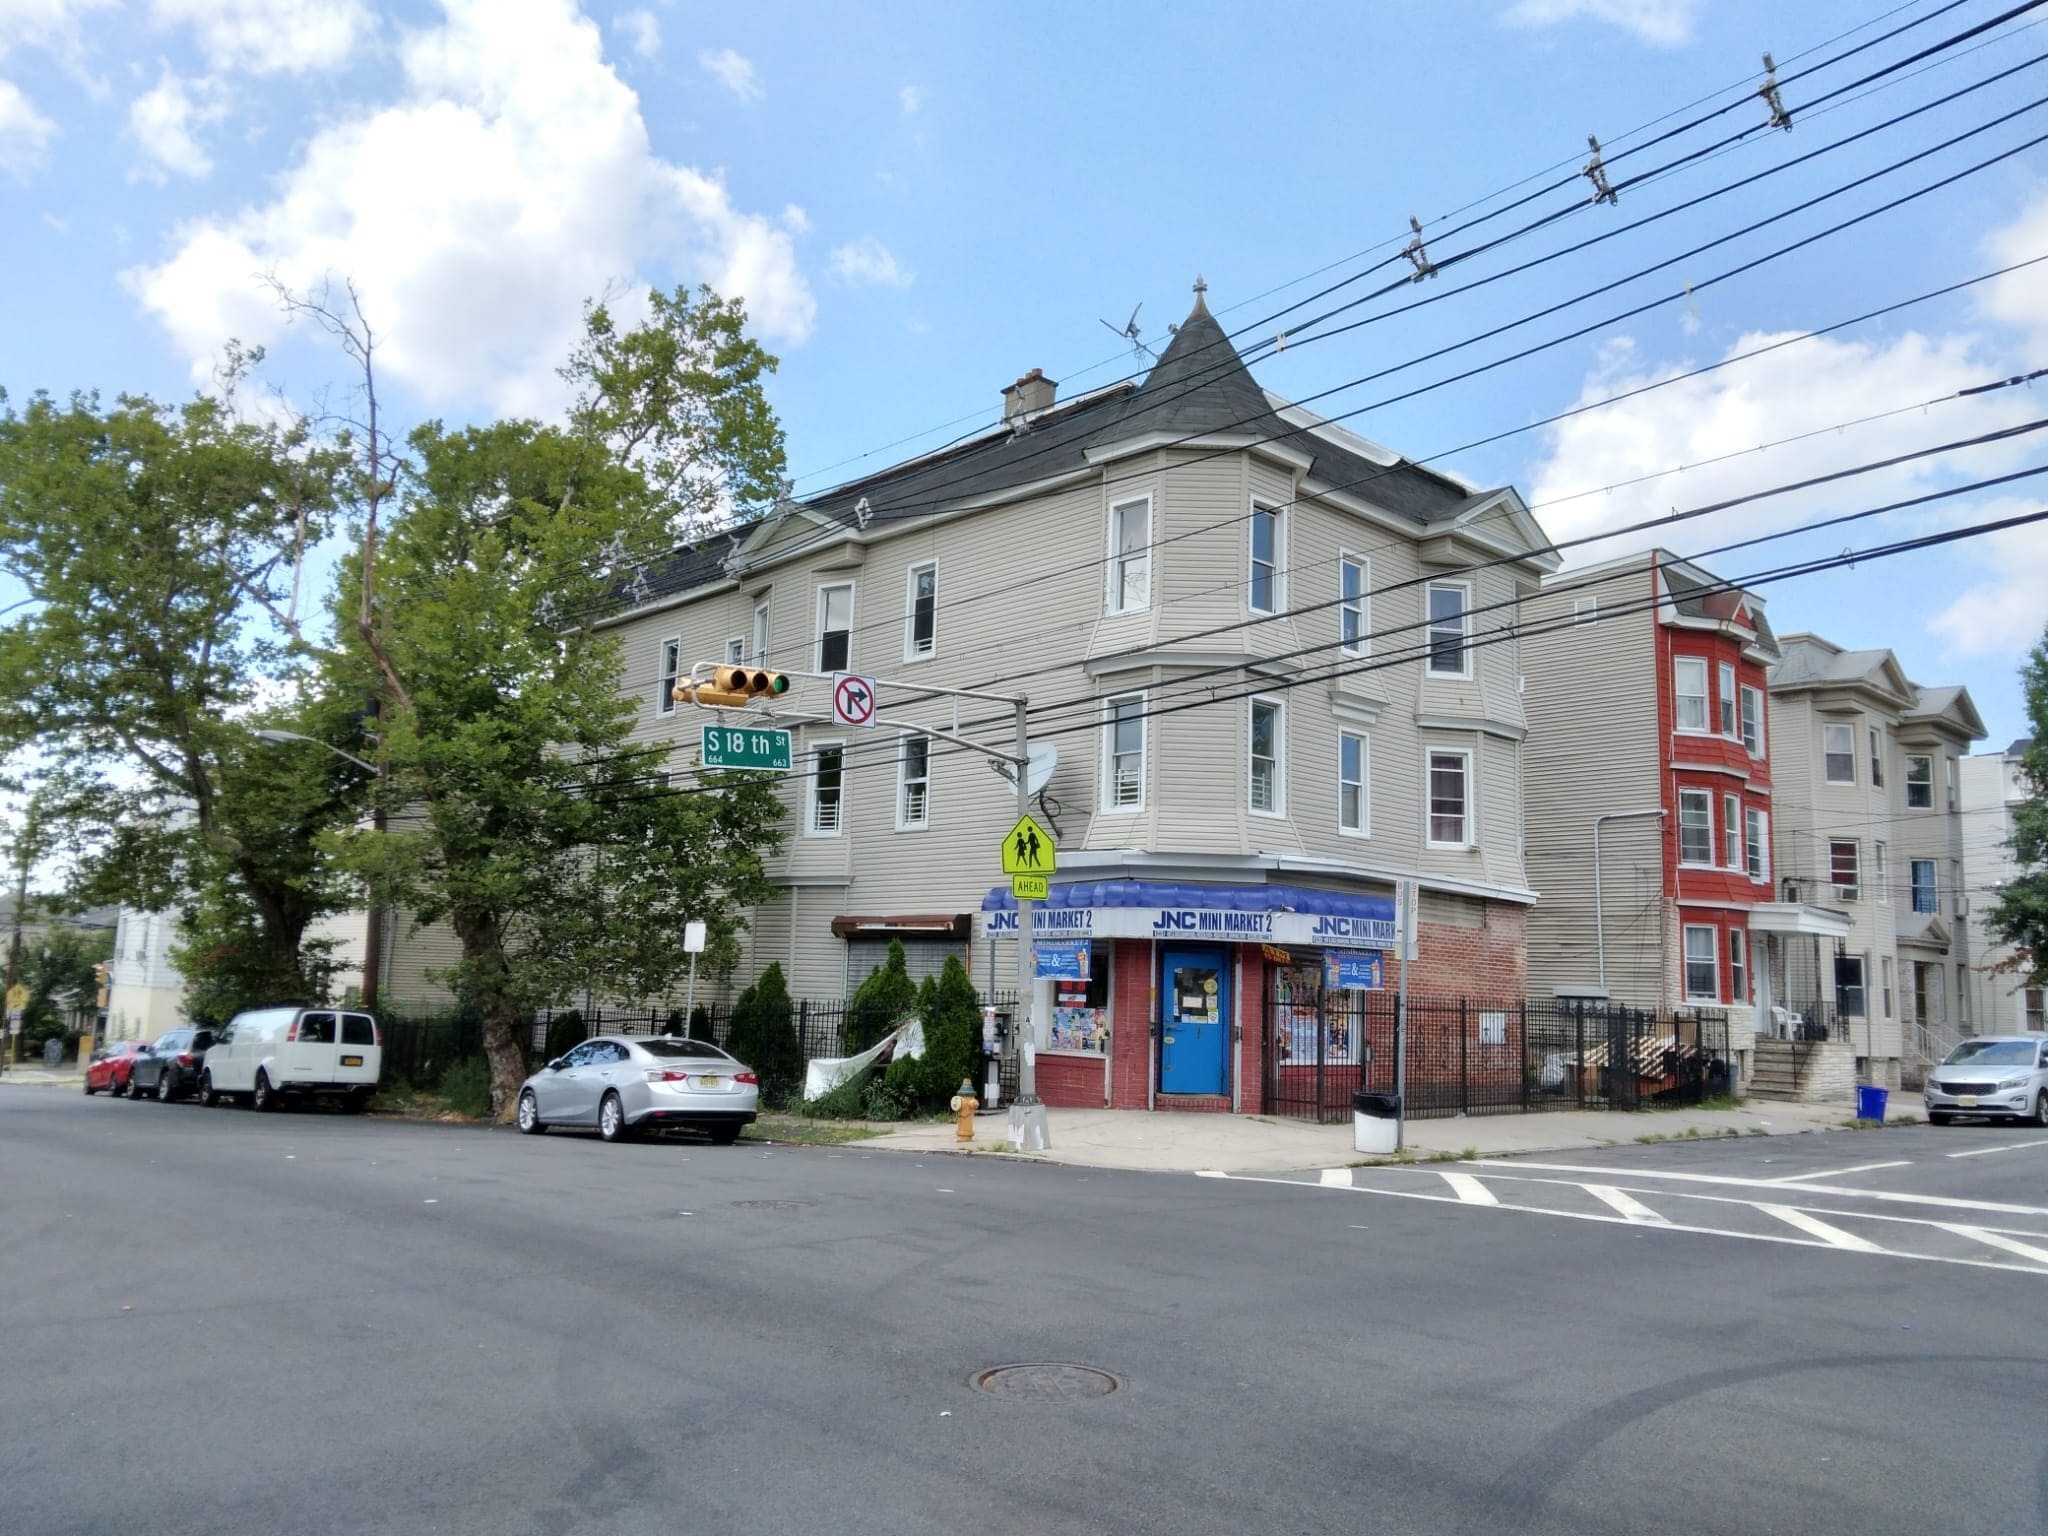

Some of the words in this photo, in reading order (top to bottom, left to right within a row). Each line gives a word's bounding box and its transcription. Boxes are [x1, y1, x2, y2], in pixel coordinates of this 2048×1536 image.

[708, 731, 720, 751] S
[726, 732, 745, 753] 18
[751, 735, 770, 754] th
[775, 736, 785, 746] St
[708, 755, 723, 764] 664
[773, 758, 787, 767] 663
[1018, 881, 1044, 893] AHEAD
[1032, 911, 1046, 929] INI
[1047, 910, 1085, 929] MARKET
[1086, 909, 1092, 928] 2
[1153, 911, 1196, 929] JNC
[1199, 911, 1222, 931] MINI
[1224, 912, 1264, 932] MARKET
[1266, 914, 1272, 932] 2
[1312, 916, 1351, 936] JNC
[1351, 919, 1371, 938] MINI
[1372, 920, 1396, 940] MARK
